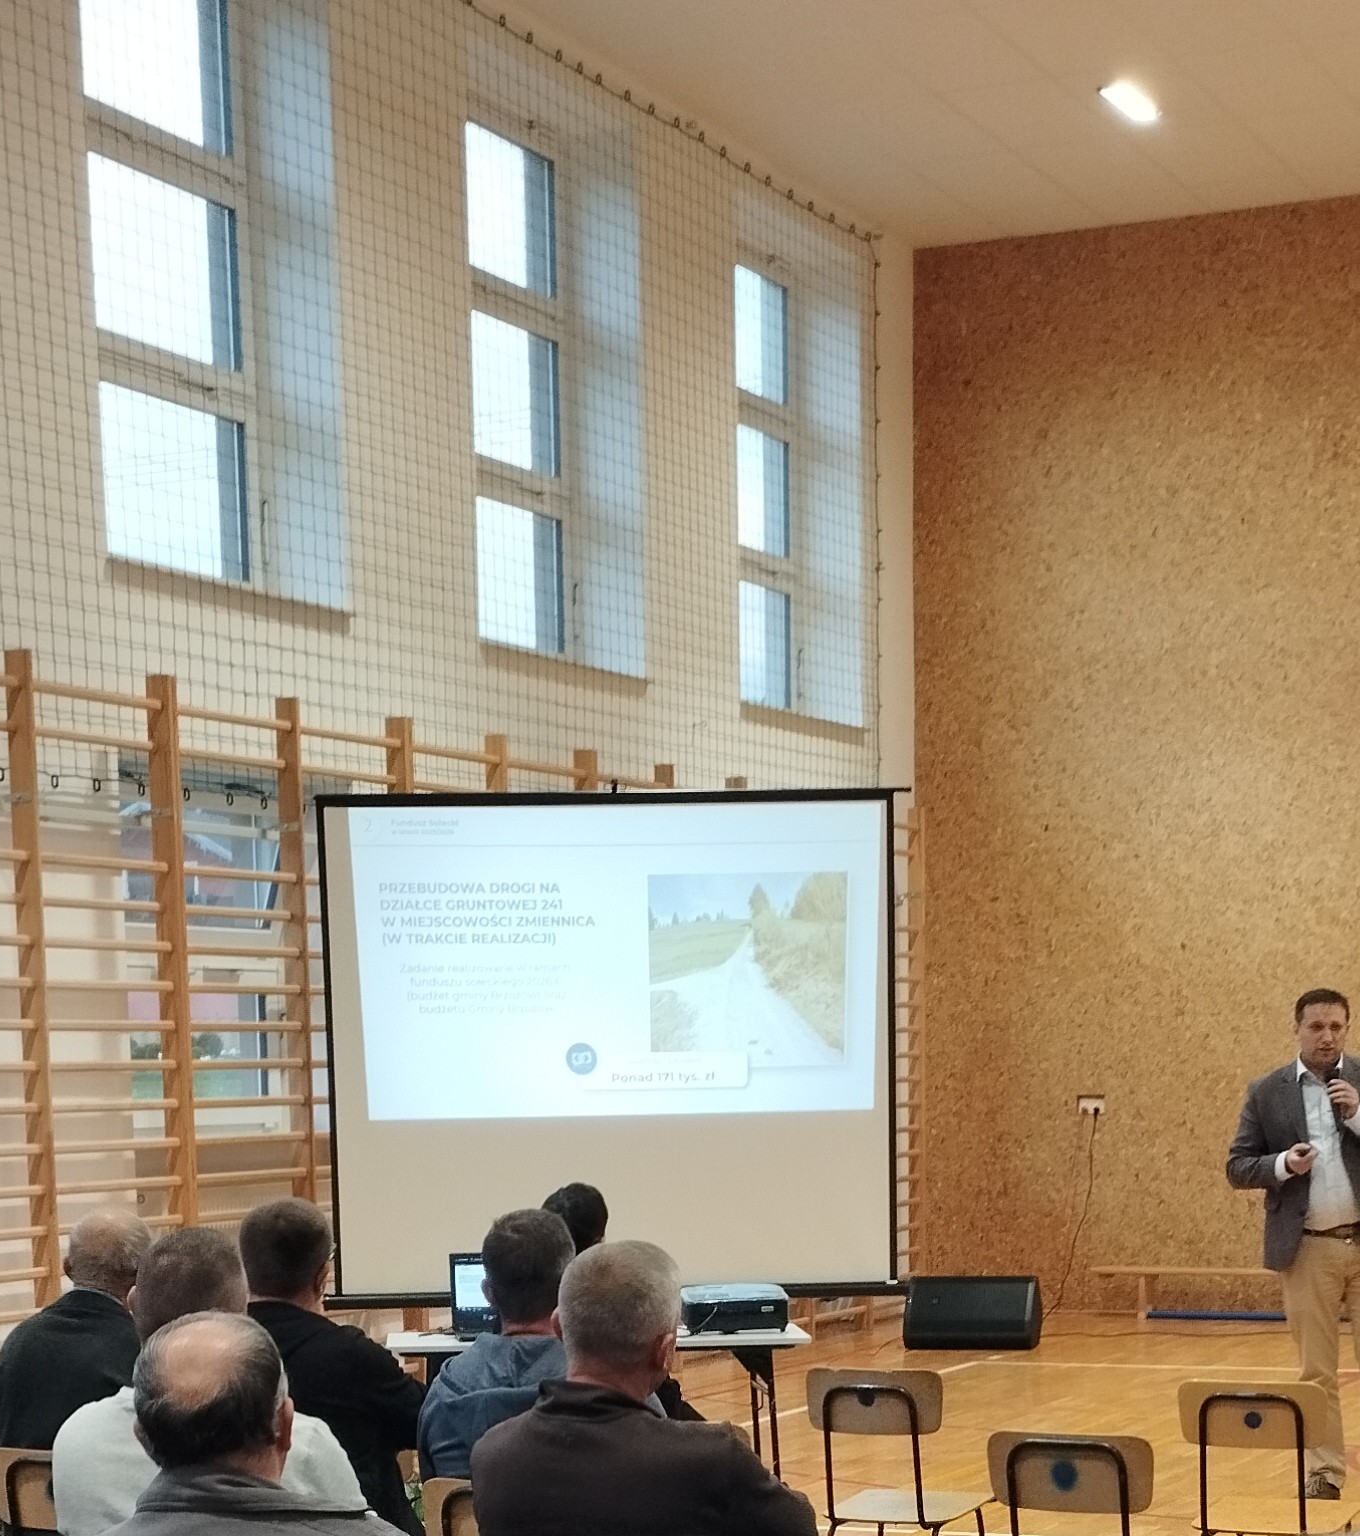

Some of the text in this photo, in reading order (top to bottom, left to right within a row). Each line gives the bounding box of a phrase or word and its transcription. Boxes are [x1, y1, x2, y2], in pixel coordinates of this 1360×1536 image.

[379, 882, 561, 895] PRZEBUDOWA DROGI NA
[380, 899, 563, 911] DZIAŁCE GRUNTOWEJ 241
[381, 914, 596, 927] W MIEJSCOWOŚCI ZMIENNICA
[382, 932, 557, 946] (W TRAKCIE REALIZACJI)
[399, 963, 445, 974] Zadanie
[410, 977, 462, 987] funduszu
[419, 1004, 465, 1015] budżetu
[611, 1072, 653, 1083] Ponad
[657, 1072, 674, 1082] 171
[704, 1071, 715, 1081] zł
